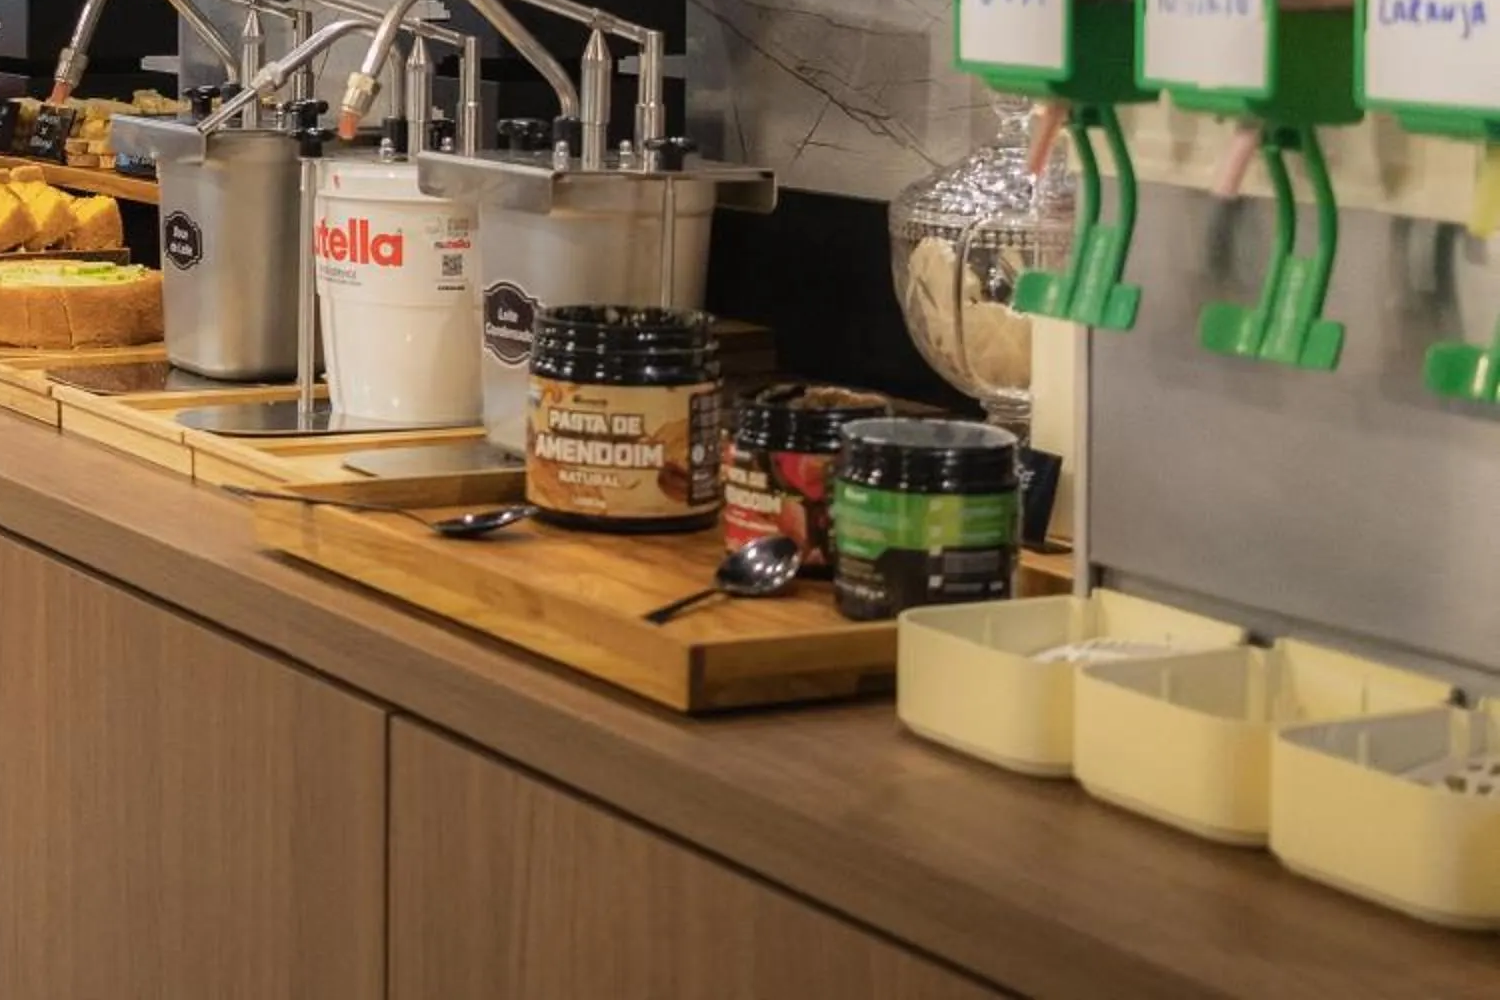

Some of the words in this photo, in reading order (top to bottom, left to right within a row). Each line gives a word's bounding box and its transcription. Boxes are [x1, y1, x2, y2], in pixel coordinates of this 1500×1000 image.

[312, 217, 403, 268] tella
[549, 410, 608, 434] PASTA
[611, 416, 642, 436] DE
[534, 433, 665, 467] AMENDOIM
[557, 468, 621, 488] NATURAL
